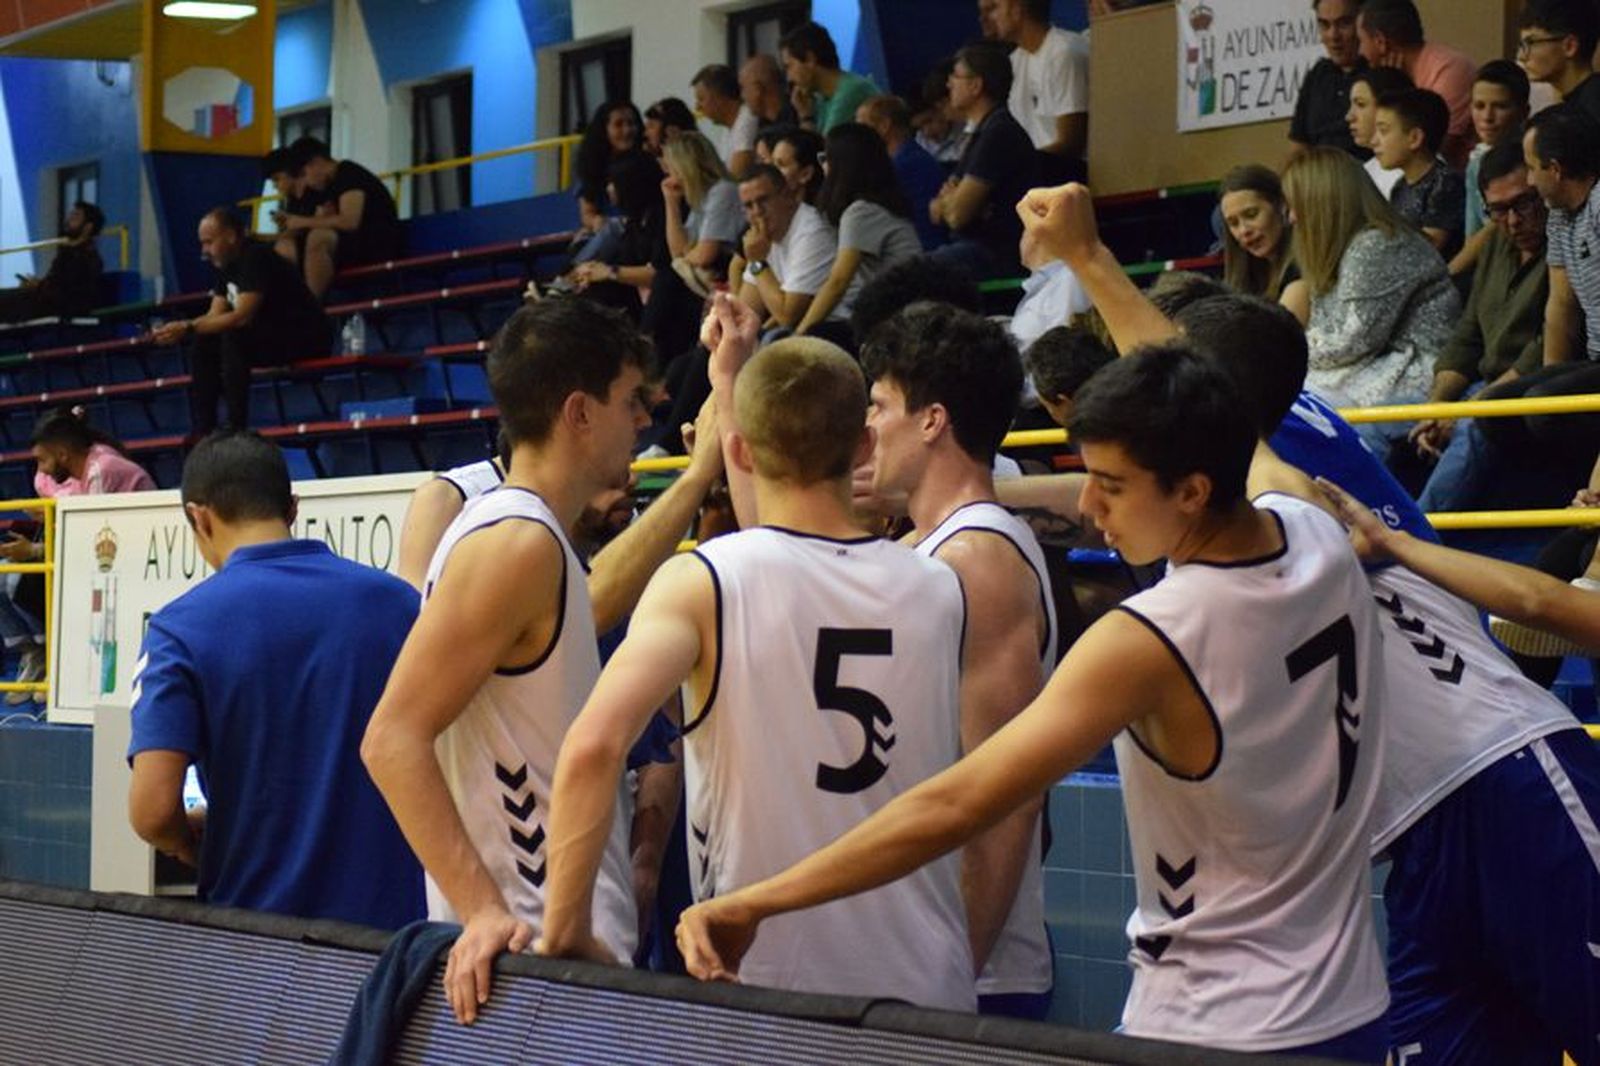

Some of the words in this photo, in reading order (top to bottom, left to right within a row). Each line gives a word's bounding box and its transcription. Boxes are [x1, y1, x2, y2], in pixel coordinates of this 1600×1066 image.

[1220, 70, 1250, 113] DE
[813, 627, 896, 793] 5
[1285, 613, 1360, 813] 7
